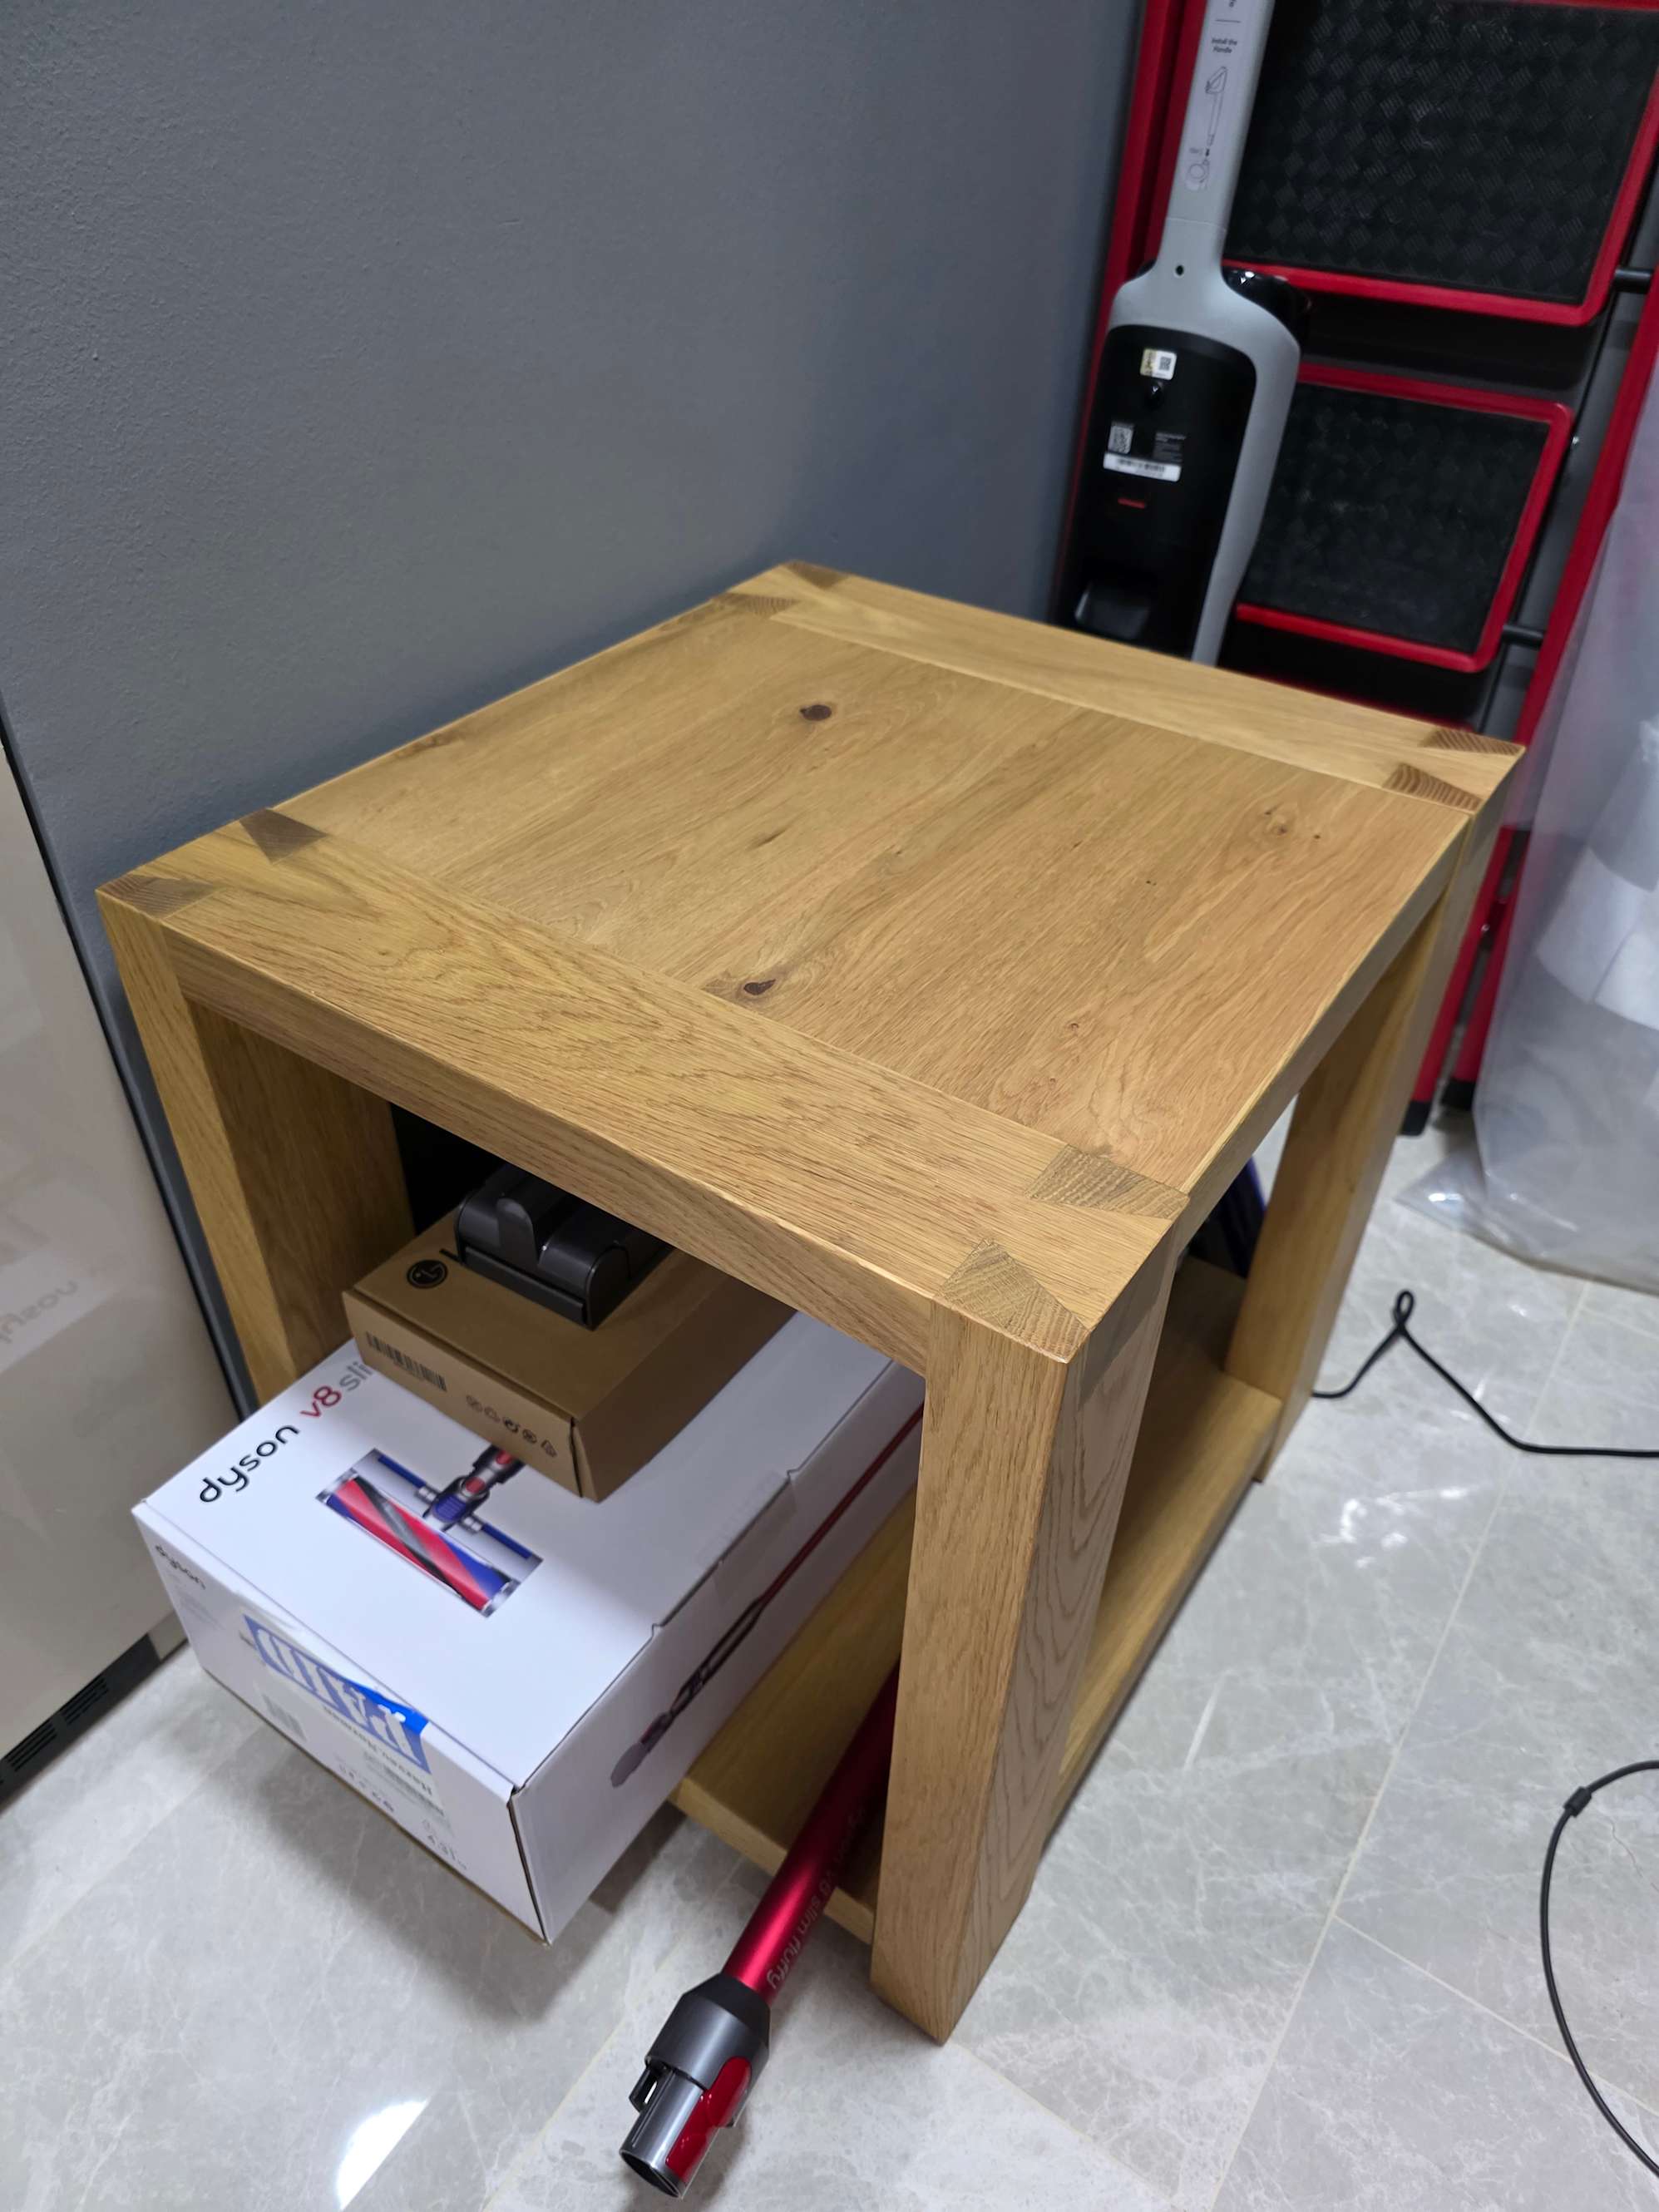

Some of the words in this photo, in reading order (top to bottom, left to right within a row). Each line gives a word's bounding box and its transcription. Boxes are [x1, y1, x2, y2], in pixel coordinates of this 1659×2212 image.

[199, 1424, 300, 1503] dyson
[299, 1385, 343, 1419] v8
[339, 1360, 373, 1391] sli
[155, 1544, 206, 1590] dyson
[767, 1938, 802, 1990] fluffy
